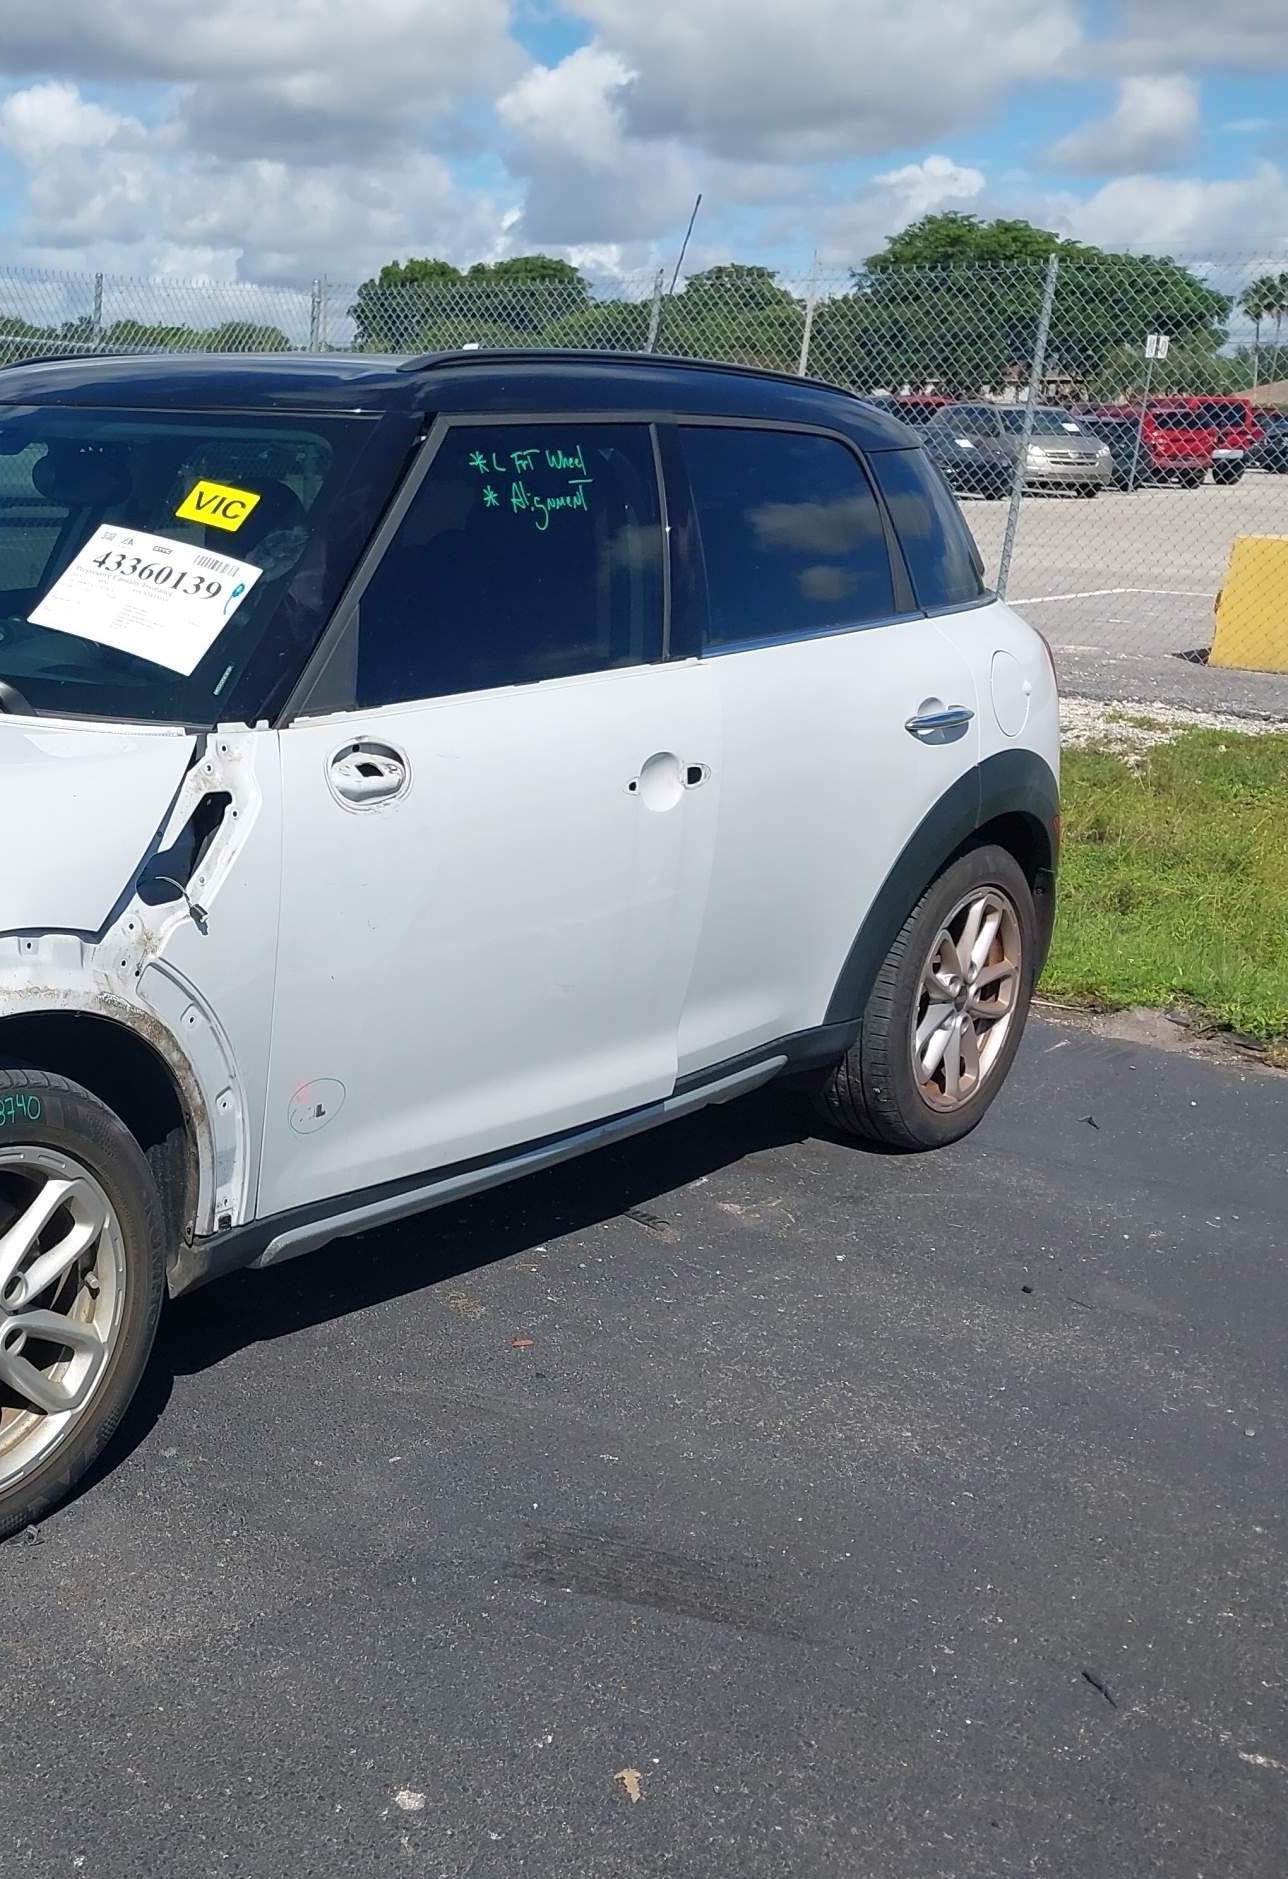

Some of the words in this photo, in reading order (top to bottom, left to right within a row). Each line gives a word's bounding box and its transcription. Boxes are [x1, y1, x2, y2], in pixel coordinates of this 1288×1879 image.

[545, 444, 588, 476] Wheel
[195, 490, 247, 520] VIC
[92, 551, 222, 600] 43360139
